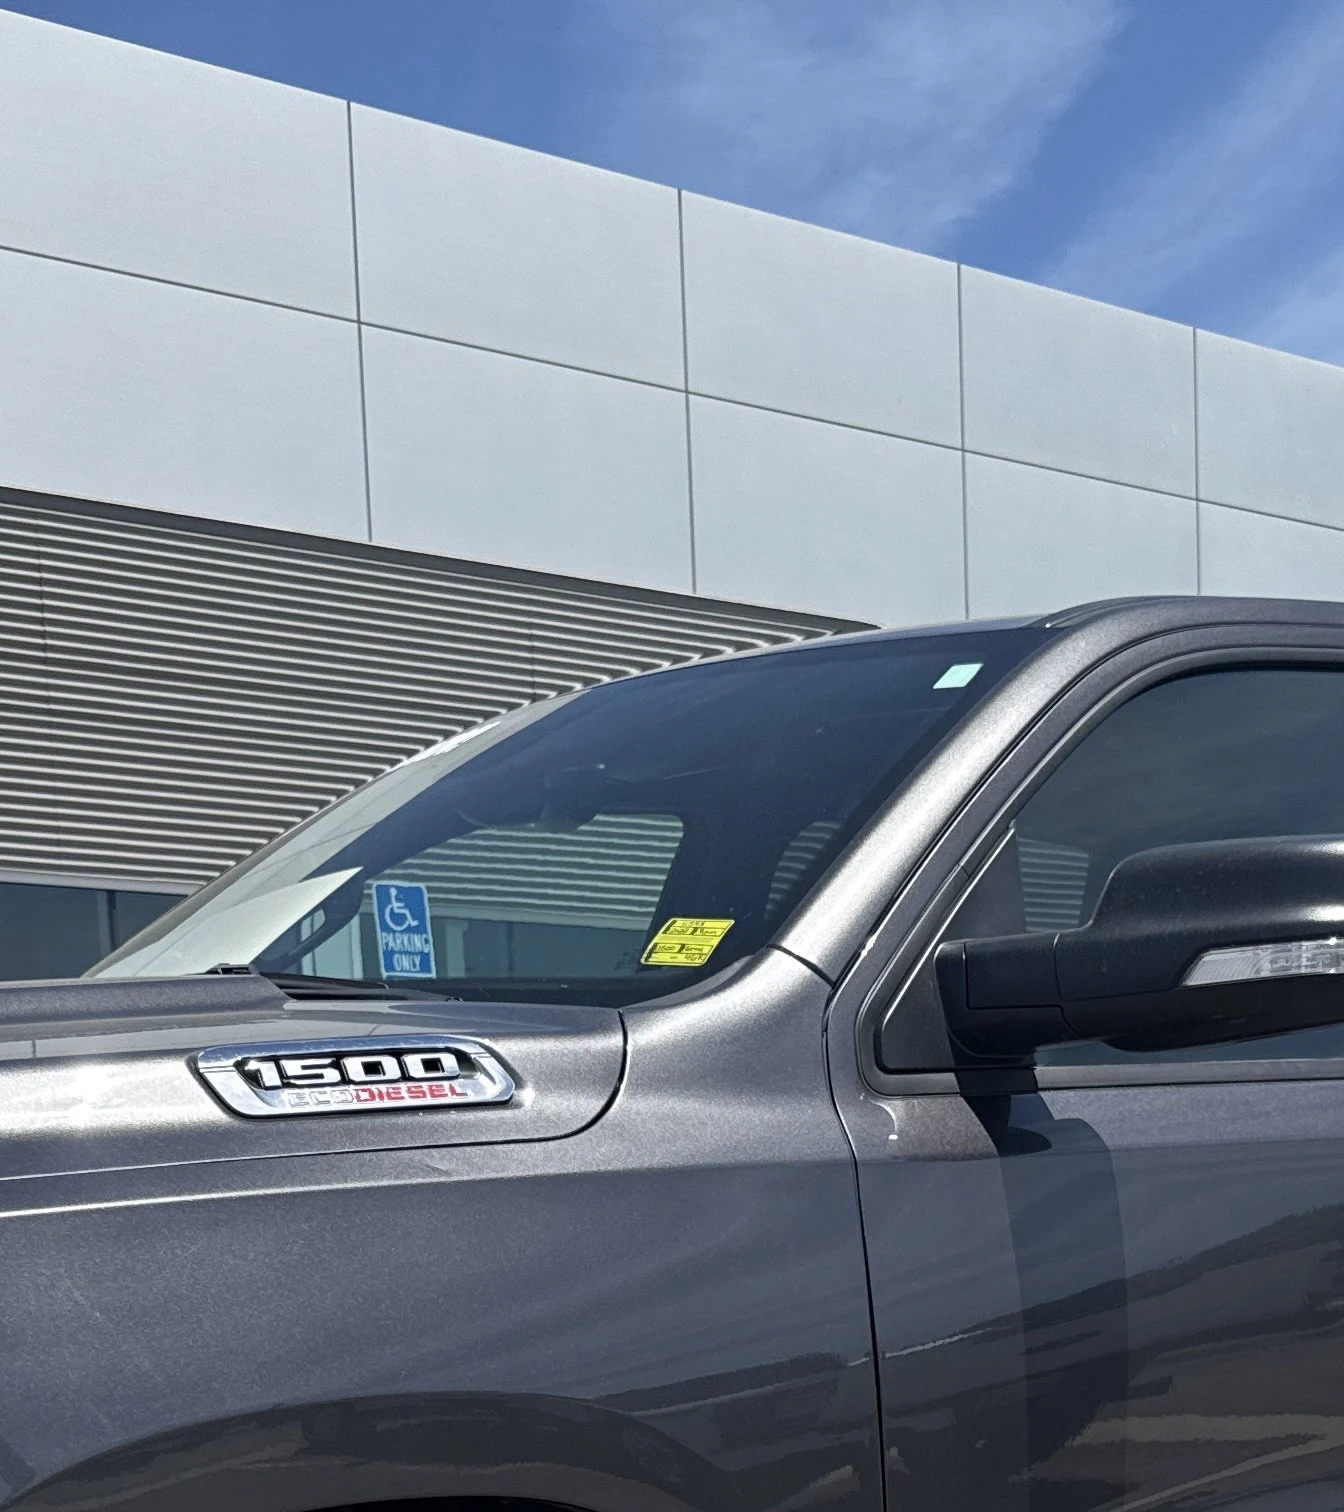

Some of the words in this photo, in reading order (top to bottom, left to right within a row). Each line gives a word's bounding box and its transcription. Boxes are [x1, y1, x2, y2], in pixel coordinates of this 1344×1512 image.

[381, 931, 431, 954] PARKING
[393, 952, 422, 972] ONLY
[244, 1051, 461, 1090] 1500
[286, 1082, 469, 1109] ECODIESEL
